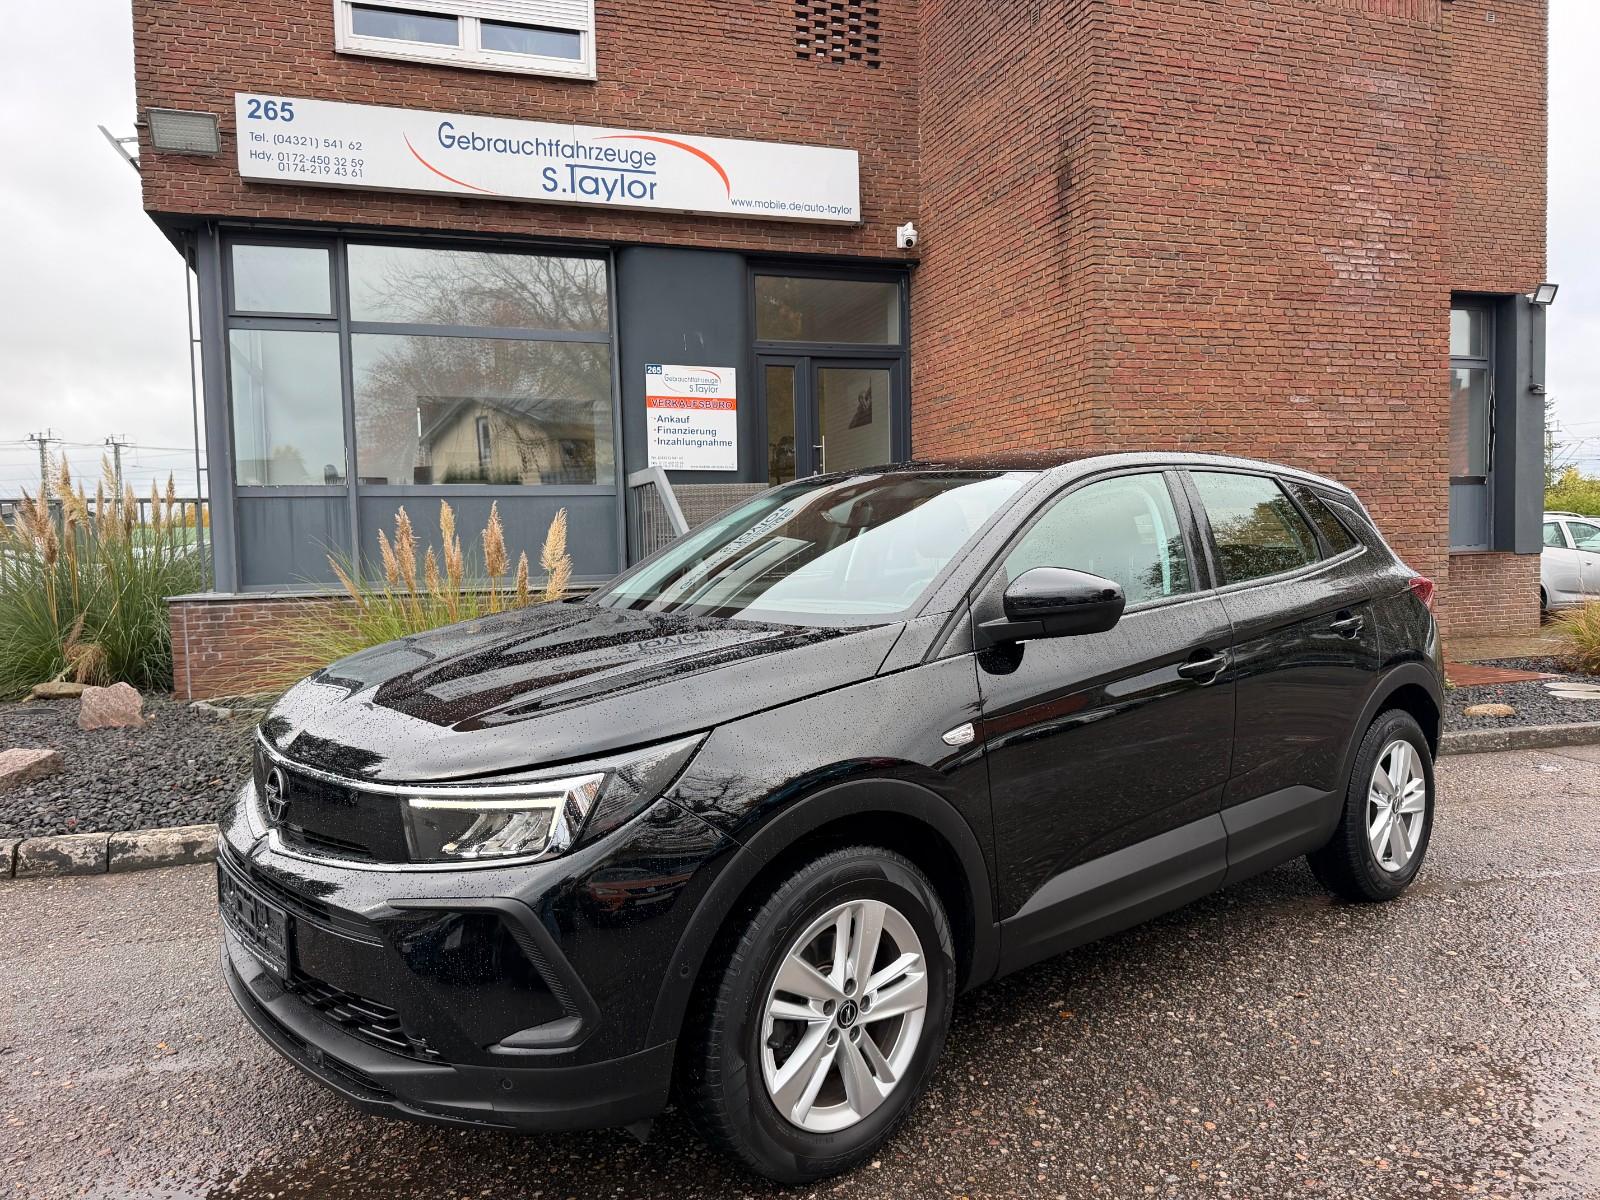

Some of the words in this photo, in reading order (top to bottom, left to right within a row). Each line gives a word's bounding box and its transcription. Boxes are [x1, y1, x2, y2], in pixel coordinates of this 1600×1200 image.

[247, 98, 294, 122] 265
[249, 132, 269, 144] Tel.
[273, 134, 319, 149] (04321)
[323, 138, 343, 149] 541
[348, 141, 363, 151] 62
[438, 121, 657, 169] Gebrauchtfahrzeuge
[249, 149, 274, 162] Hdy.
[277, 152, 331, 166] 0172-450
[334, 156, 348, 167] 32
[350, 158, 364, 168] 59
[278, 162, 331, 176] 0174-219
[334, 166, 348, 177] 43
[351, 168, 363, 178] 61
[542, 163, 657, 202] S.Taylor
[730, 197, 853, 216] www.mobile.de/auto-taylor
[647, 366, 661, 374] 265
[657, 415, 690, 424] Ankauf
[657, 426, 717, 437] Finanzierung
[657, 437, 733, 448] Inzahlungnahme
